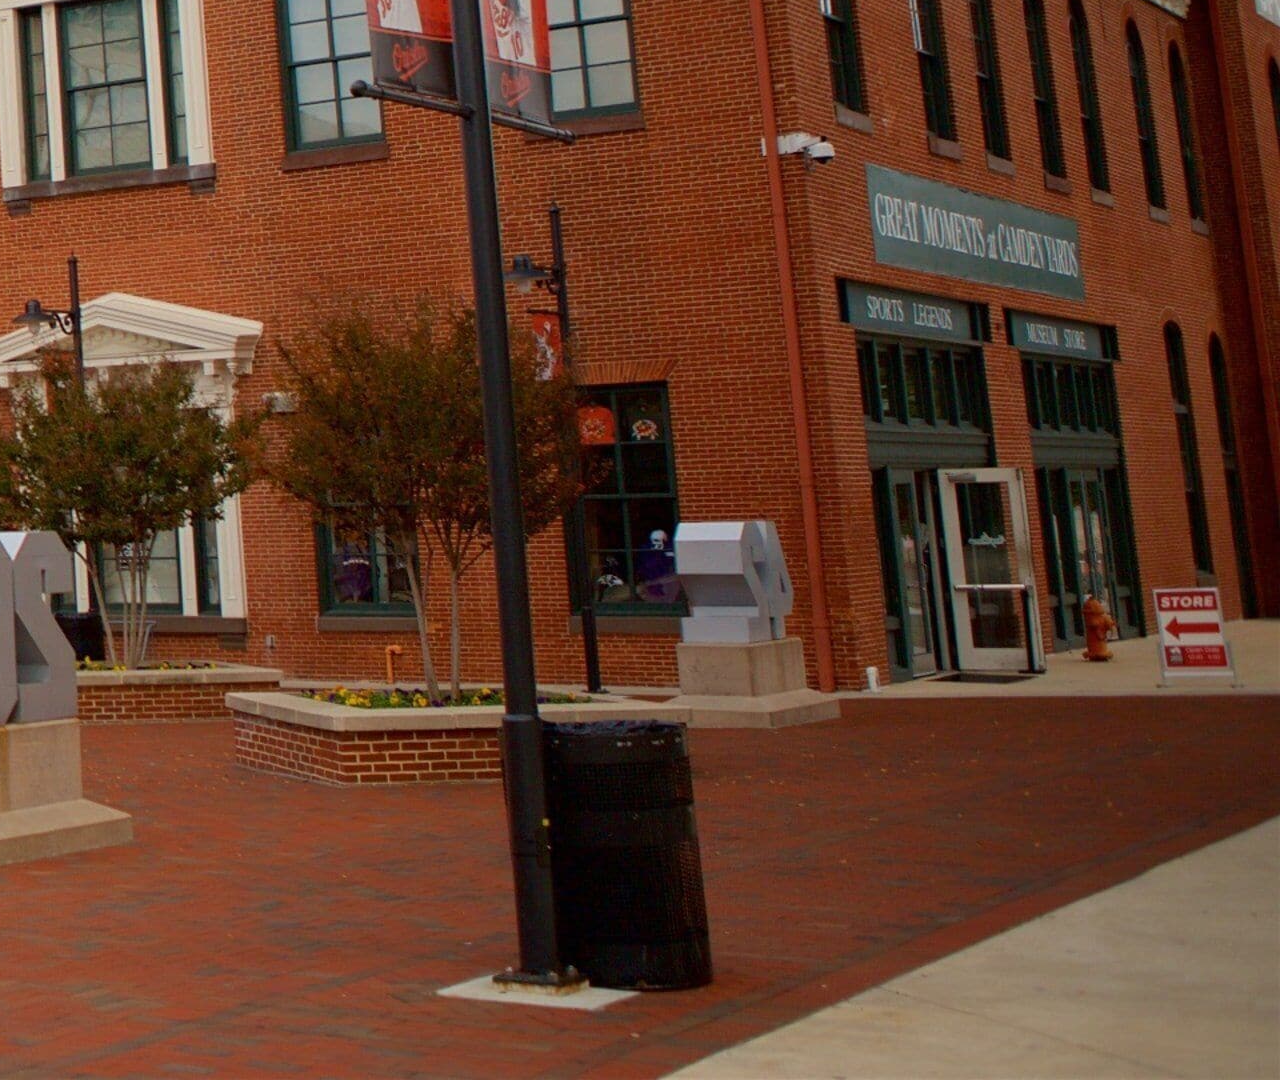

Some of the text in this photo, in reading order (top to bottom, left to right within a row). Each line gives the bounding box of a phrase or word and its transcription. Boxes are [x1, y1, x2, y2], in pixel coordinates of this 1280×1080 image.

[875, 192, 920, 244] GREAT
[921, 204, 986, 259] MOMENTS
[998, 223, 1045, 270] CAMDEN
[1043, 235, 1079, 278] YARDS
[866, 295, 953, 331] SPORTS LEGENDS
[1025, 322, 1086, 351] MUSEUM STORE
[1160, 595, 1215, 609] STORE
